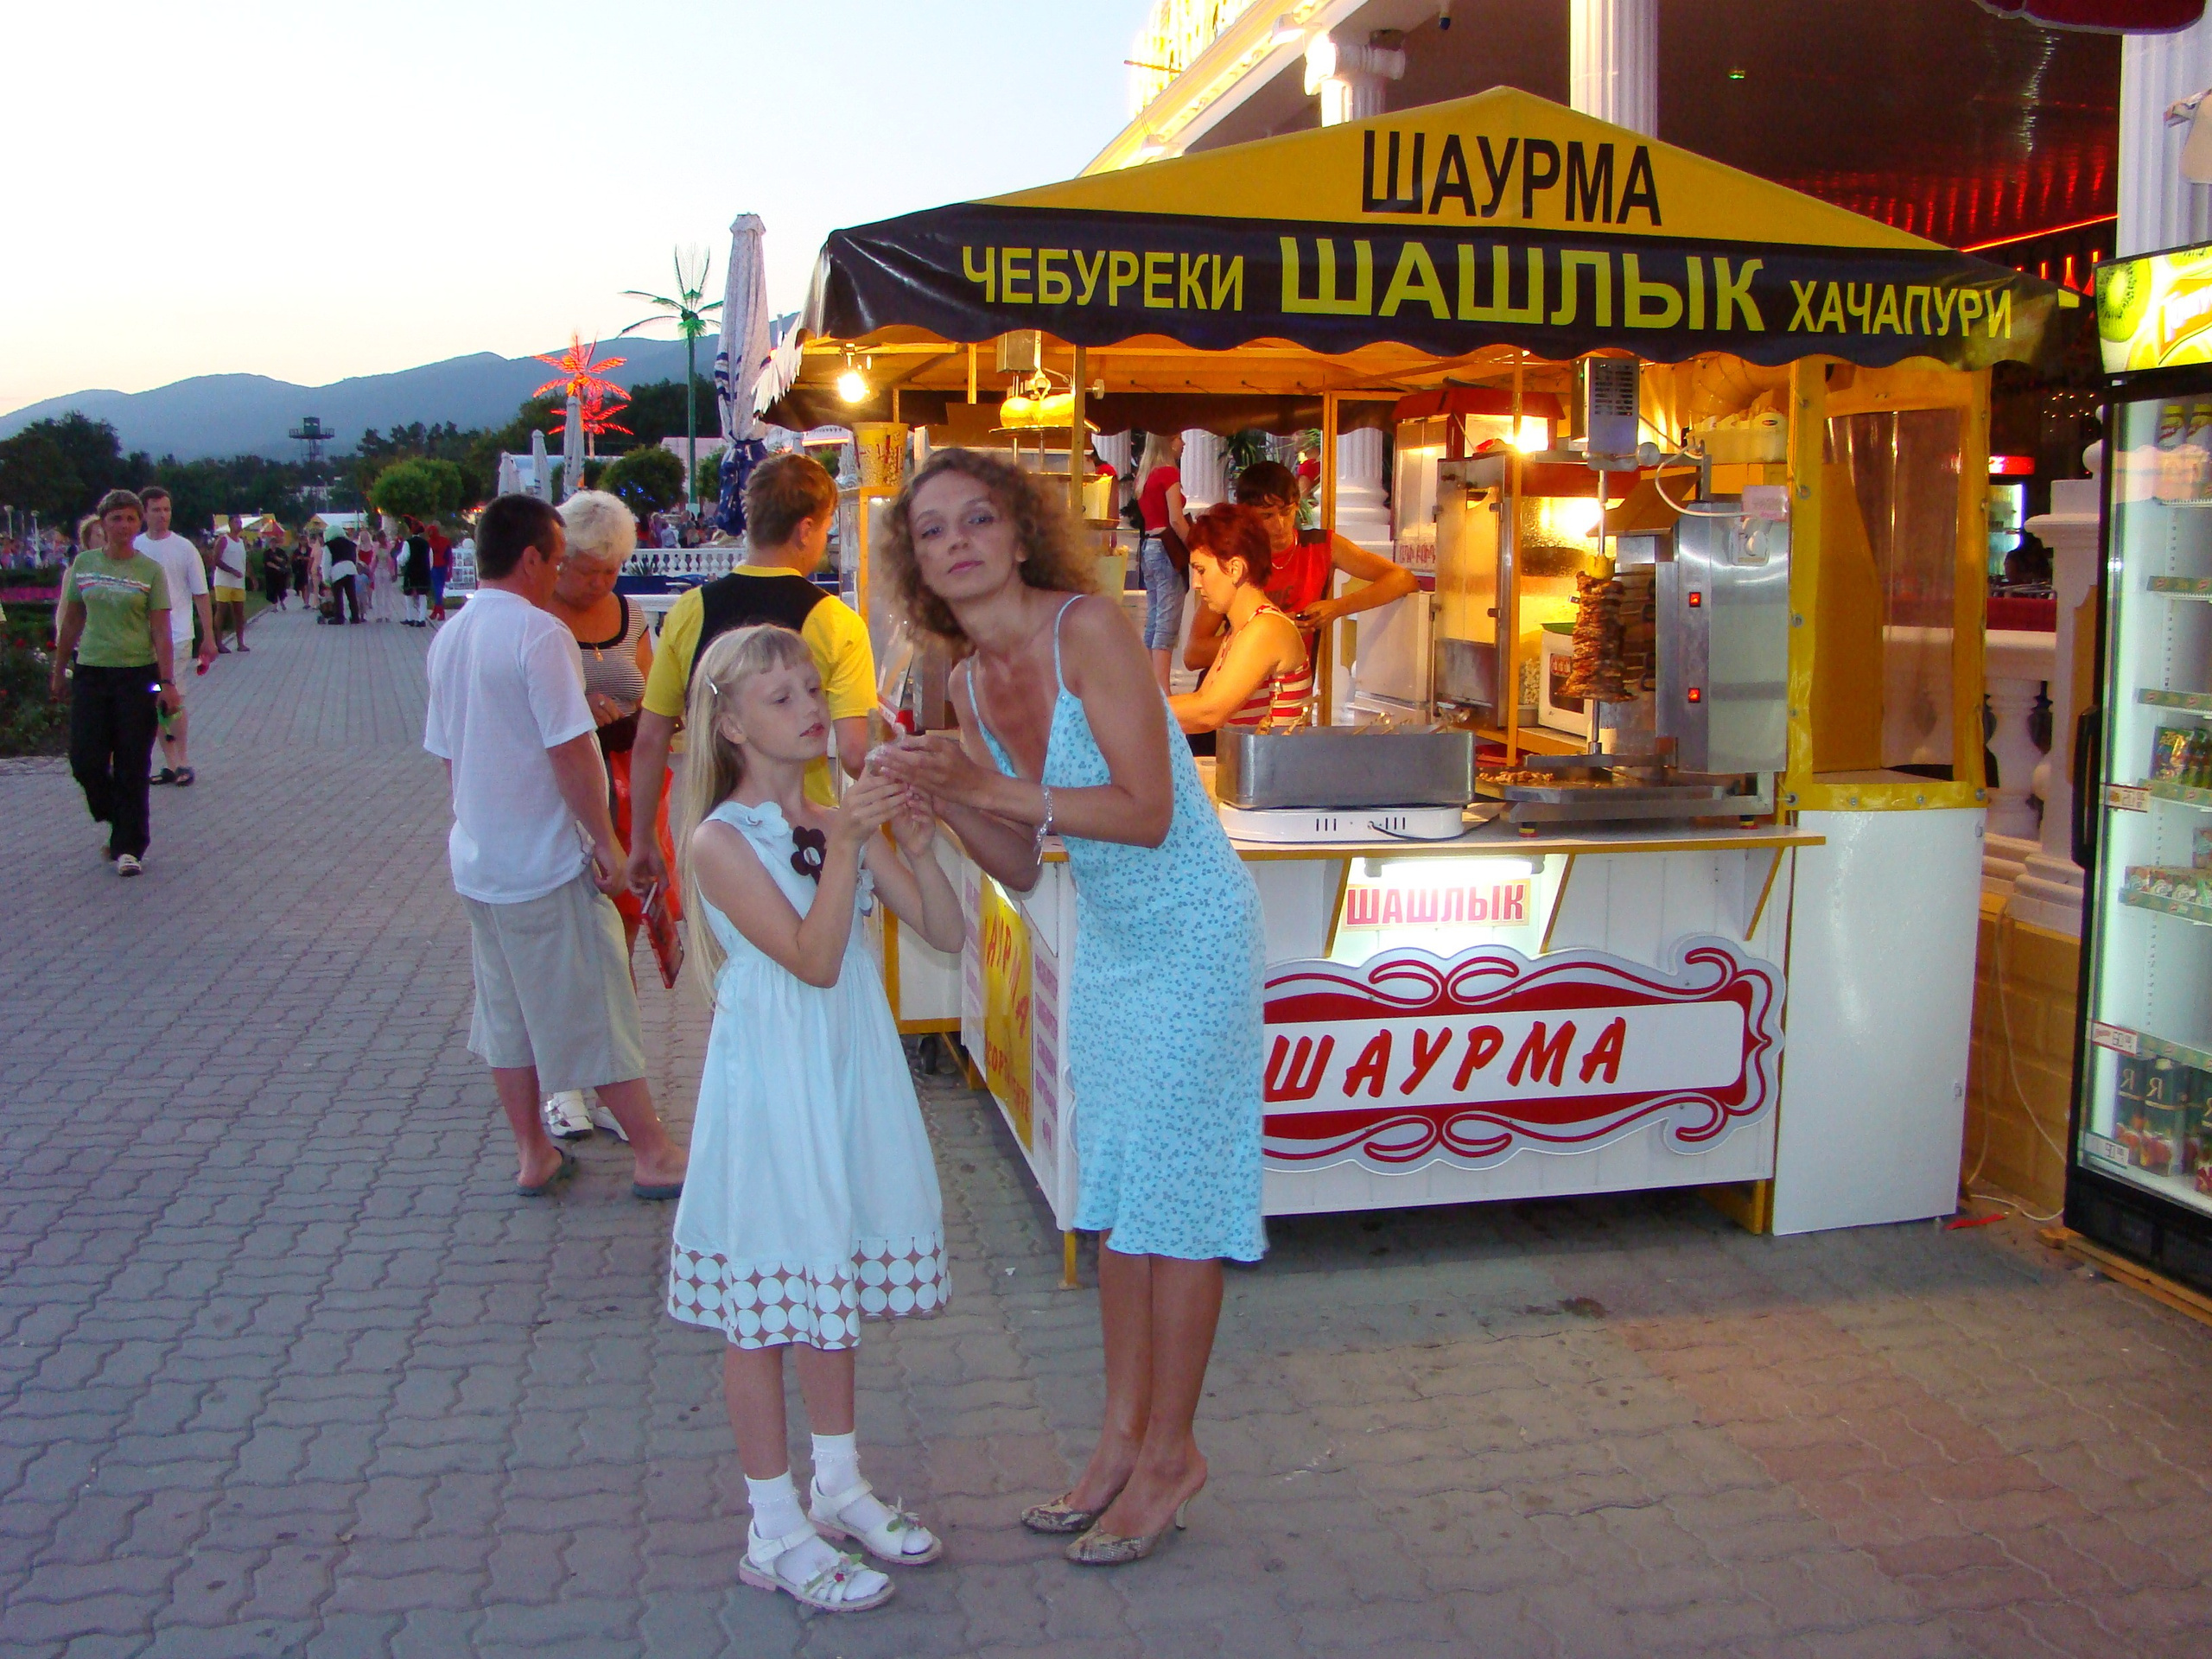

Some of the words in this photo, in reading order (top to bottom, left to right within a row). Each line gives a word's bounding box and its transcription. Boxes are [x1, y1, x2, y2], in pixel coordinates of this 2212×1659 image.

[1362, 130, 1662, 227] ШАУРМА
[963, 245, 1243, 312] ЧЕБУРЕКИ
[1279, 236, 1764, 332] ШАШЛЫК
[1788, 280, 2011, 339] ХАЧАПУРИ
[1347, 884, 1524, 925] ШАШЛЫК
[1264, 1016, 1626, 1102] ШАУРМА
[2146, 1077, 2163, 1100] Я
